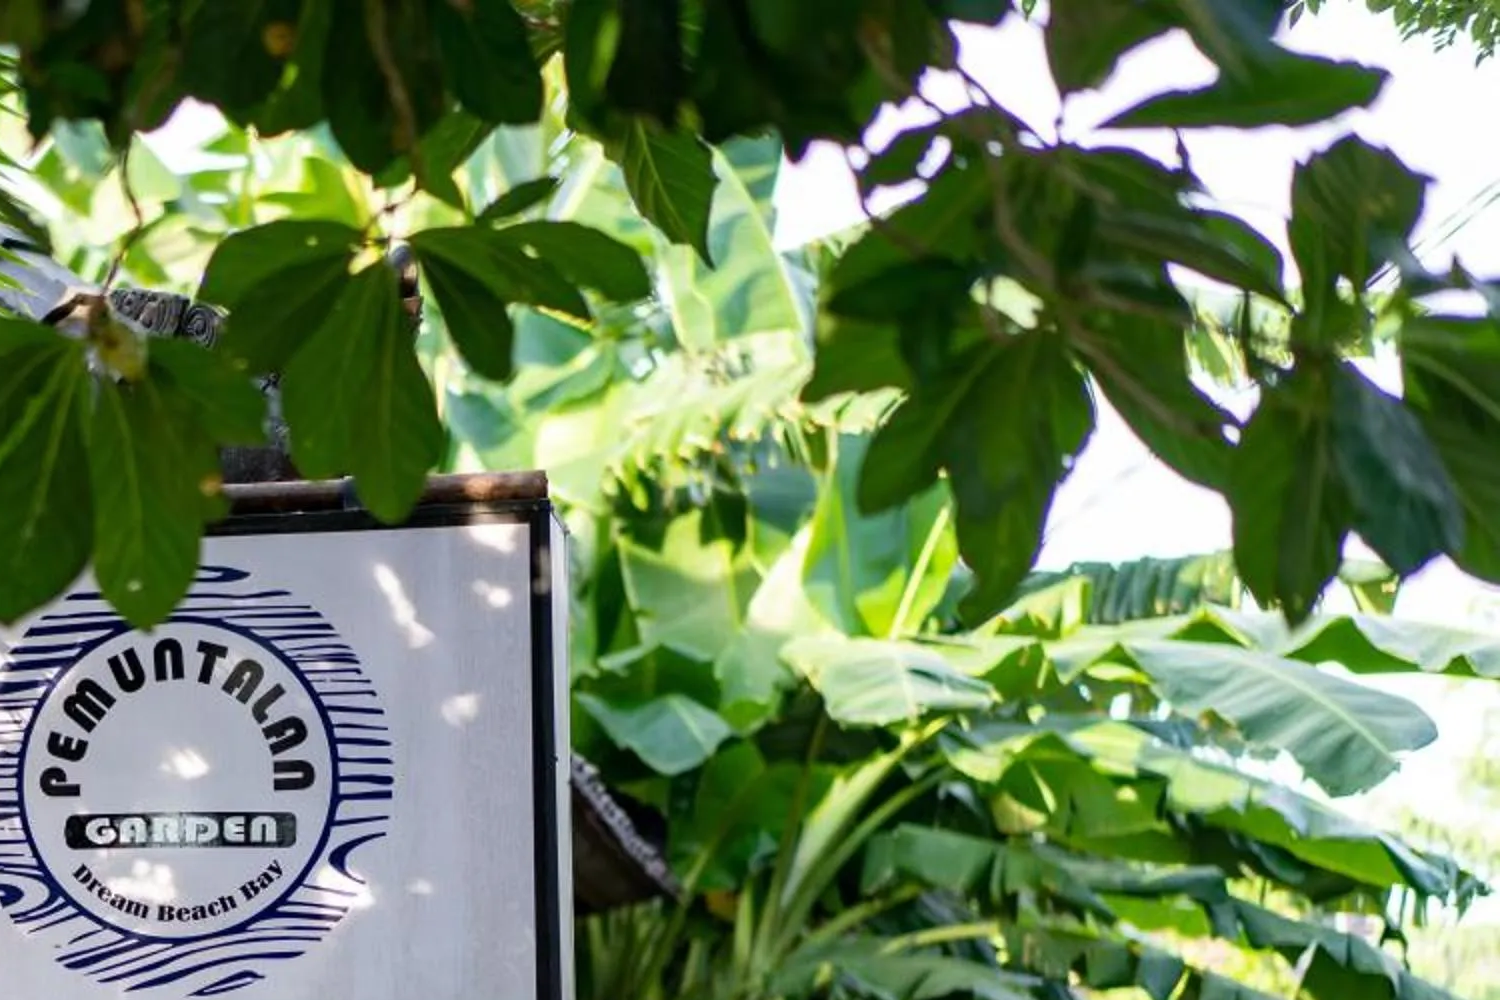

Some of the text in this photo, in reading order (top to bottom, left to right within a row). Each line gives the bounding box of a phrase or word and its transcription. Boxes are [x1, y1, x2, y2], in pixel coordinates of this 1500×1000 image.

[40, 637, 315, 797] PEMUNTALAN
[85, 816, 277, 844] GARDEN
[72, 859, 283, 922] Dream Beach Bay
